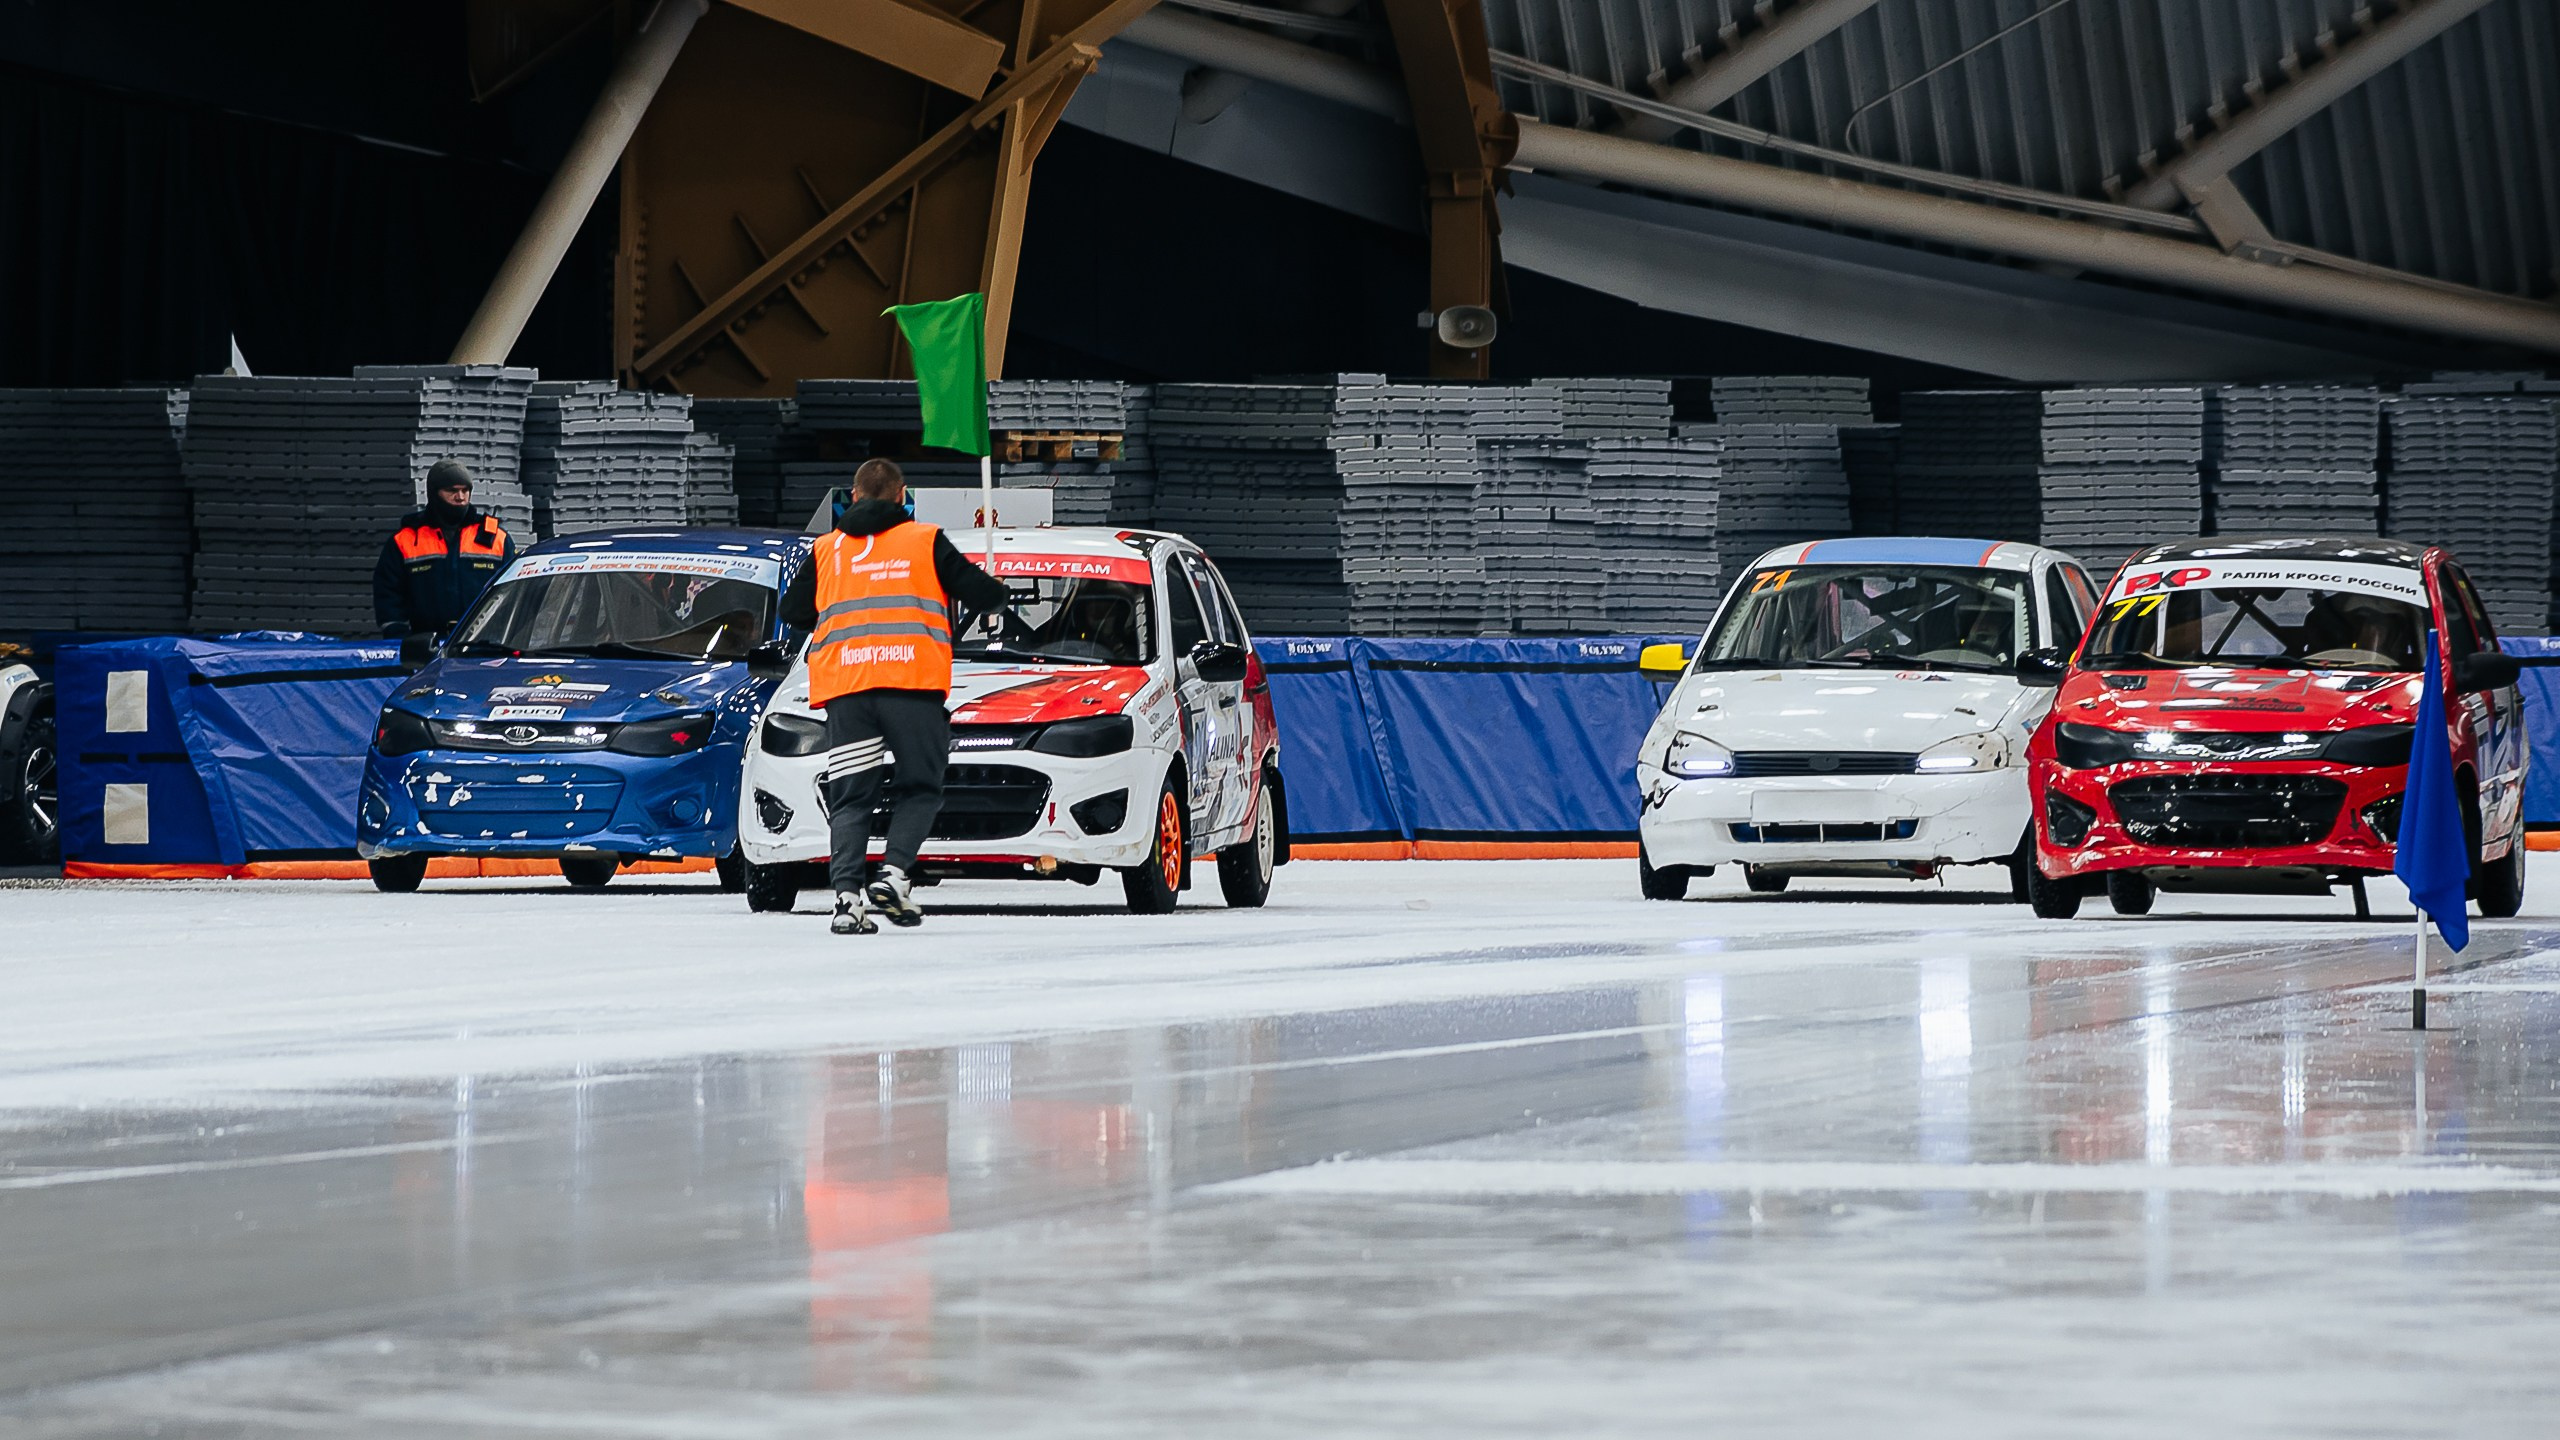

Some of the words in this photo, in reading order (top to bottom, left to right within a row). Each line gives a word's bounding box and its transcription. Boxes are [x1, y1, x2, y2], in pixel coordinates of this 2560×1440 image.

[1000, 561, 1056, 572] RALLY
[1060, 562, 1111, 575] TEAM
[1751, 570, 1792, 593] 71
[2222, 571, 2280, 580] РАЛЛИ
[2285, 572, 2342, 583] КРОСС
[2347, 577, 2418, 596] РОССИИ
[2112, 594, 2167, 622] 77
[841, 644, 915, 667] Новокузнецк
[1297, 643, 1331, 653] OLYMP
[1589, 645, 1625, 655] OLYMP
[1206, 733, 1234, 762] ALINA
